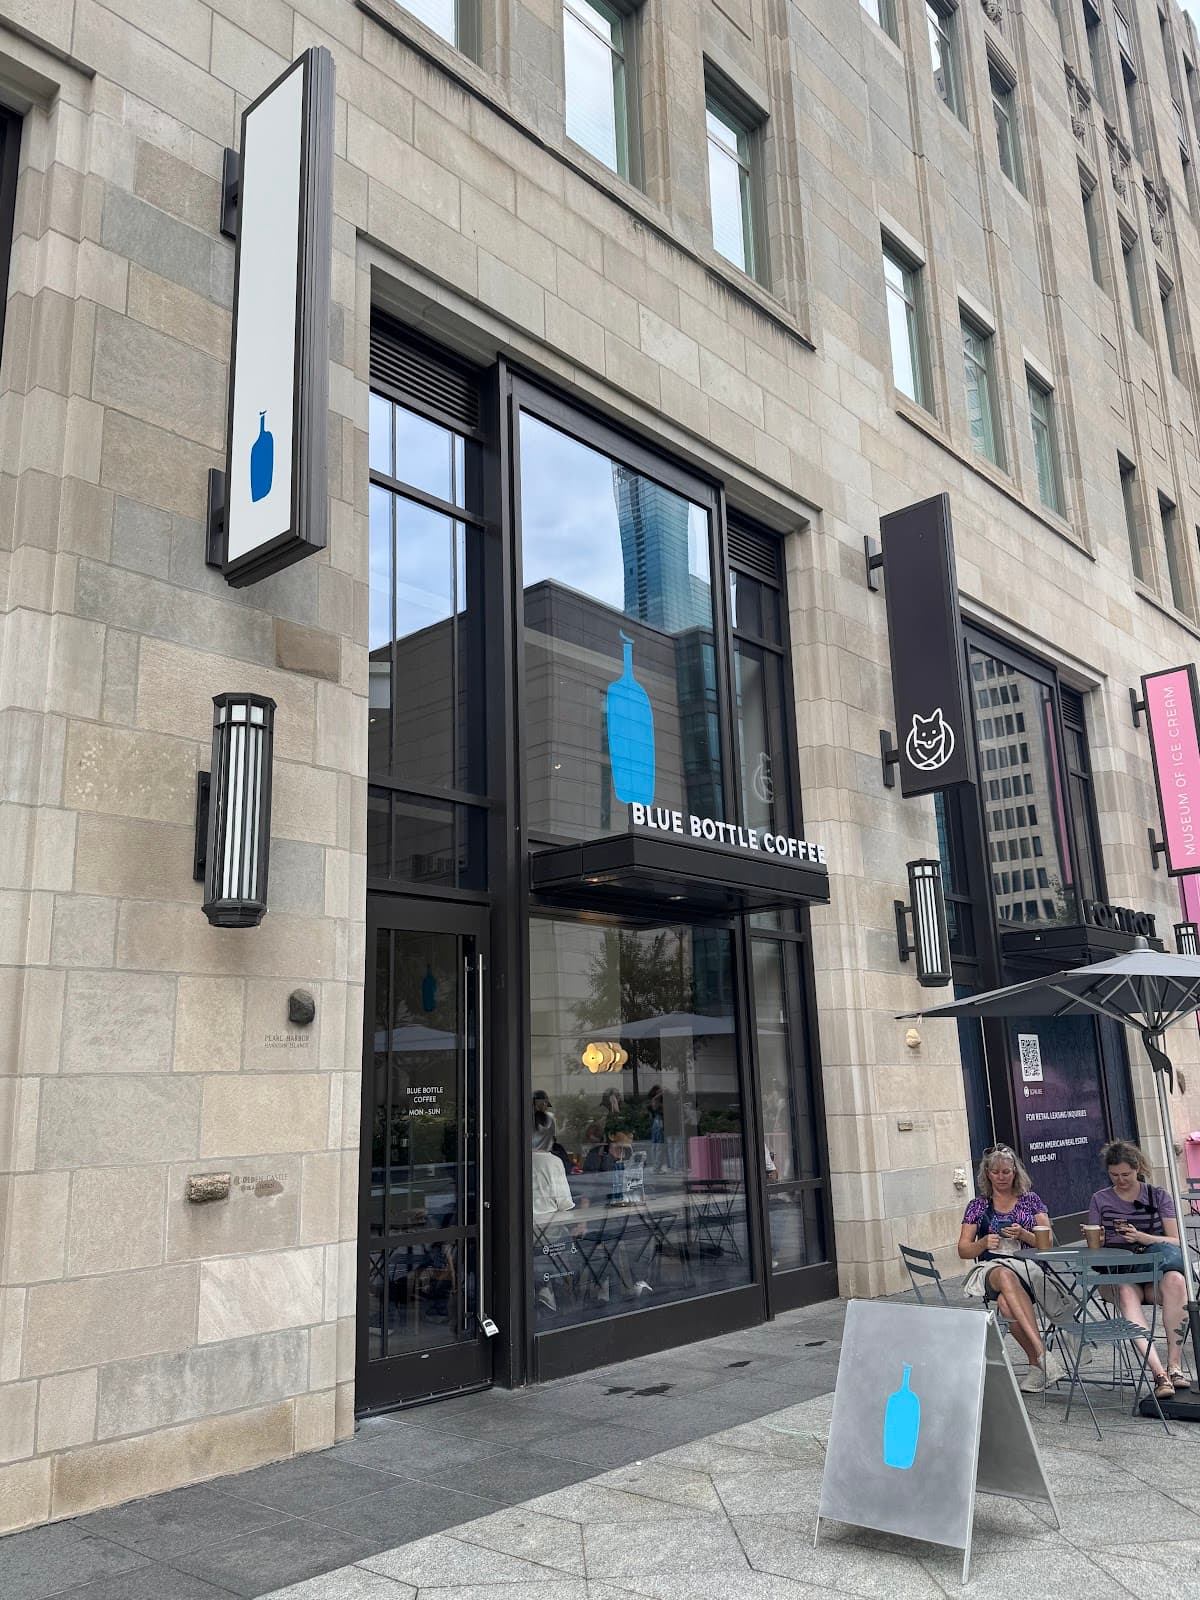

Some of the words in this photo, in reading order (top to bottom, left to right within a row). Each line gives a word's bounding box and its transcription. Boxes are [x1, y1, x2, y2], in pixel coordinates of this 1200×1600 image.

[1163, 686, 1180, 738] CREAM
[1171, 742, 1184, 766] ICE
[1174, 772, 1186, 788] OF
[632, 802, 684, 834] BLUE
[690, 814, 759, 851] BOTTLE
[763, 832, 827, 864] COFFEE
[1178, 793, 1196, 856] MUSEUM
[1025, 1113, 1036, 1121] FOR
[1035, 1112, 1050, 1120] RETAIL
[1049, 1110, 1067, 1119] LEASING
[1067, 1109, 1087, 1119] INQUIRIES
[1029, 1142, 1044, 1150] NORTH
[1045, 1140, 1065, 1149] AMERICAN
[1065, 1138, 1075, 1146] REAL
[1075, 1137, 1088, 1145] ESTATE
